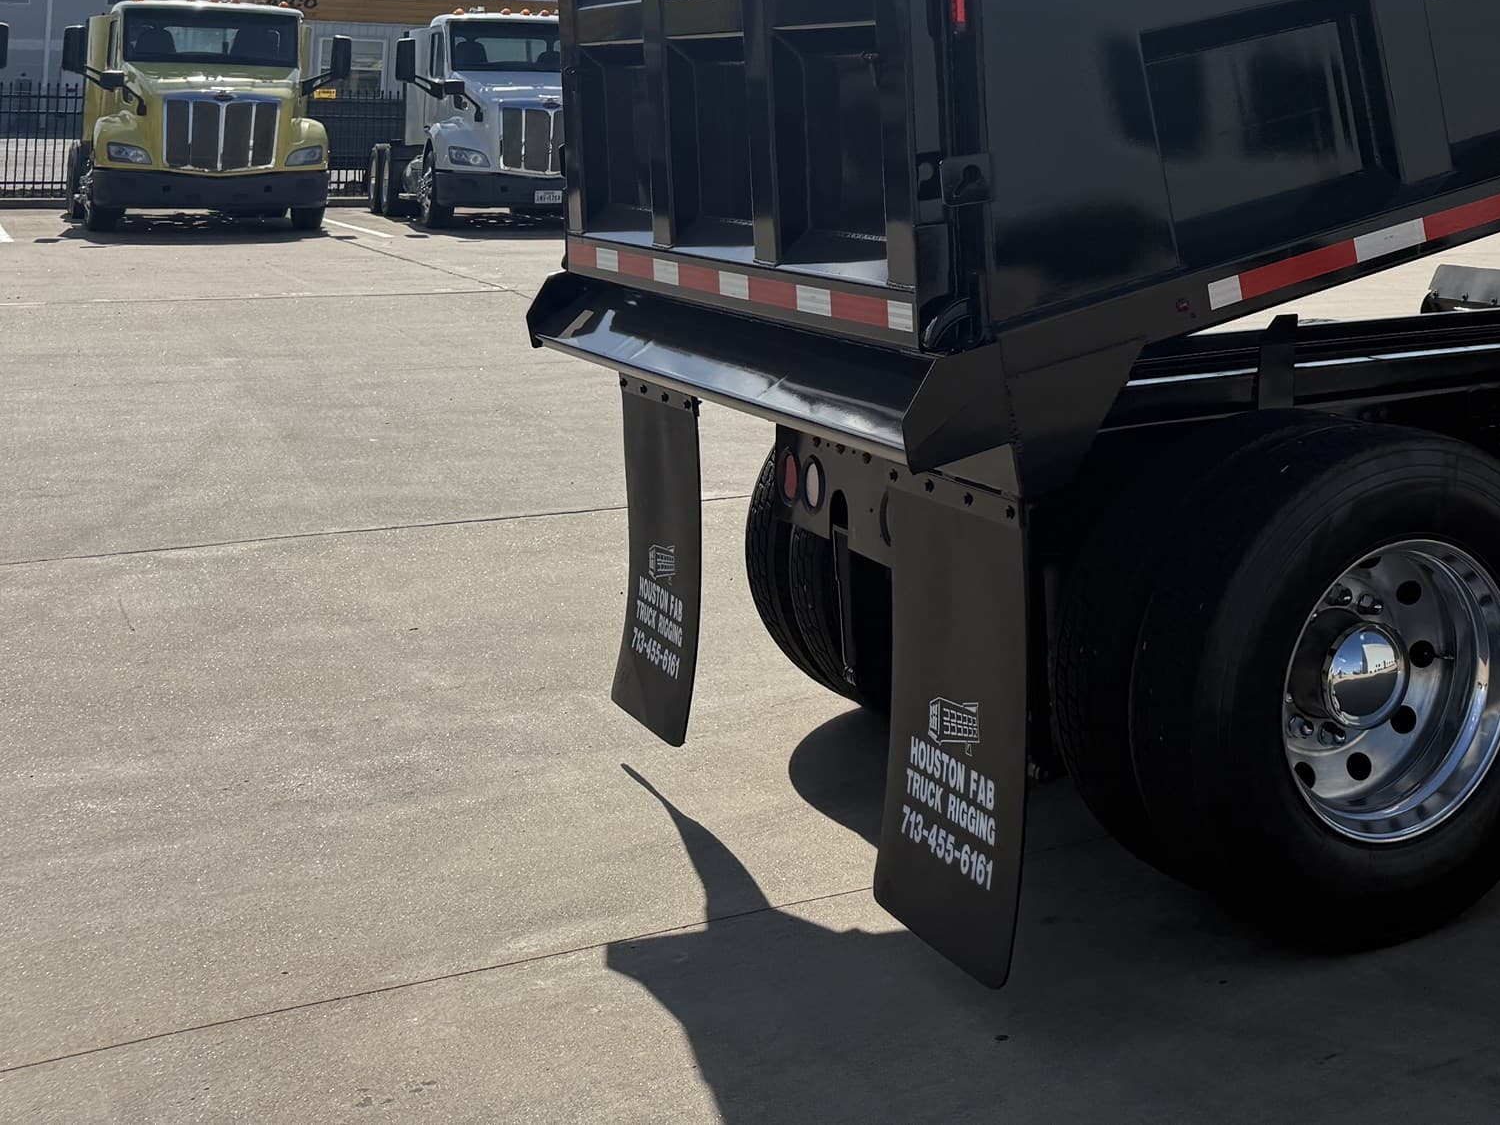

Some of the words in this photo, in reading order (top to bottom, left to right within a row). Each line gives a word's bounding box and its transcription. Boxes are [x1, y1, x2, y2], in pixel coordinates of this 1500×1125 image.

[636, 599, 657, 629] TRUCK
[657, 614, 683, 648] RIGGING
[639, 575, 669, 614] HOUSTON
[669, 594, 683, 623] FAB
[631, 627, 680, 680] 713-455-6161
[910, 736, 966, 794] HOUSTON
[969, 769, 995, 811] FAB
[906, 767, 944, 814] TRUCK
[947, 793, 996, 847] RIGGING
[901, 804, 994, 891] 713-455-6161
